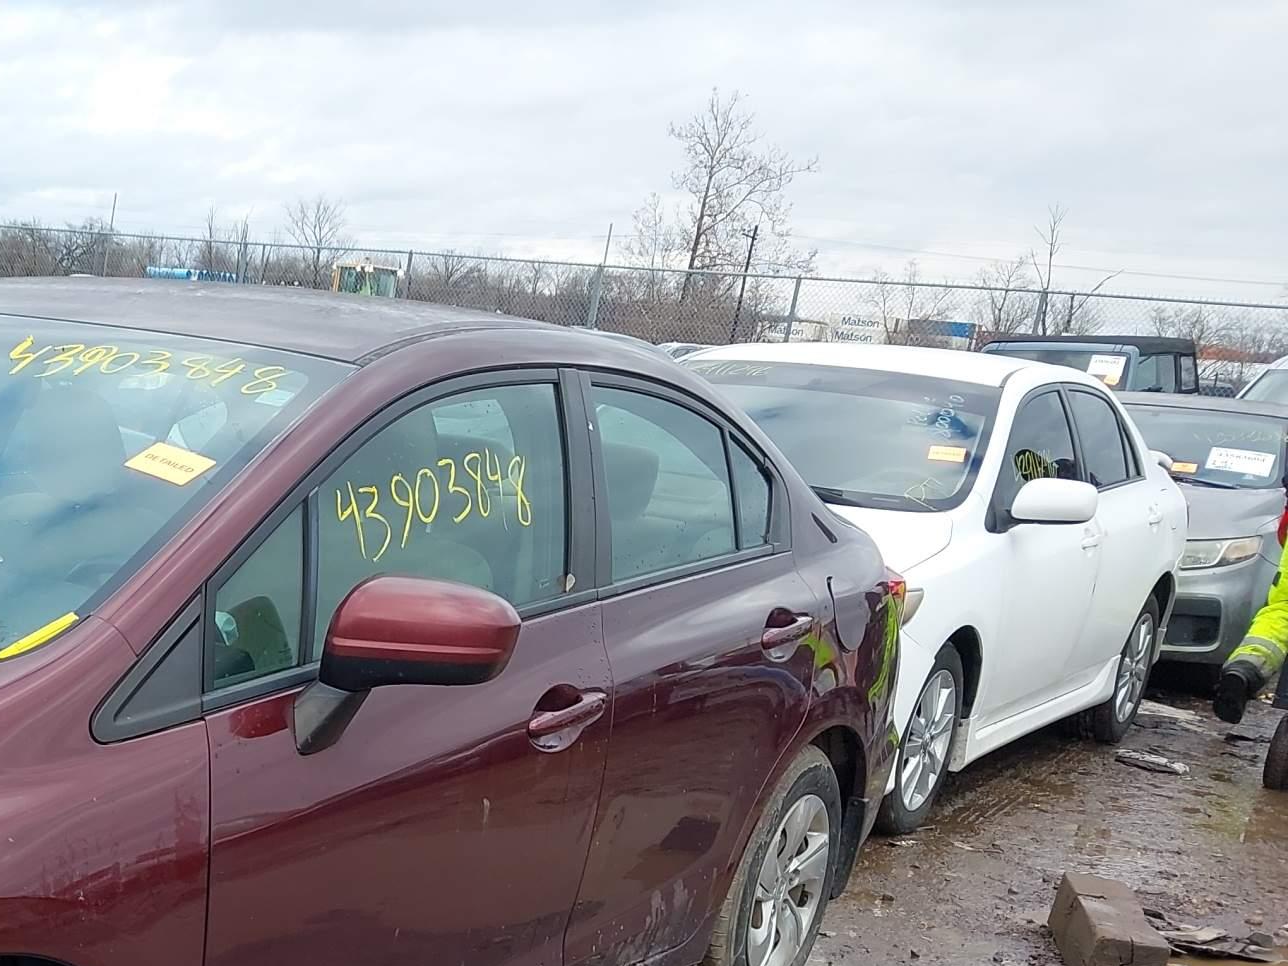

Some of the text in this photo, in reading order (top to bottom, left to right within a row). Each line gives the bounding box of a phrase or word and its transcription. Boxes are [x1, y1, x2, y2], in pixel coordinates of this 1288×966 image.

[841, 316, 880, 328] Matson
[834, 330, 873, 342] Matson
[8, 334, 286, 394] 43903848
[144, 453, 195, 473] DETAILED
[336, 447, 532, 562] 43903848
